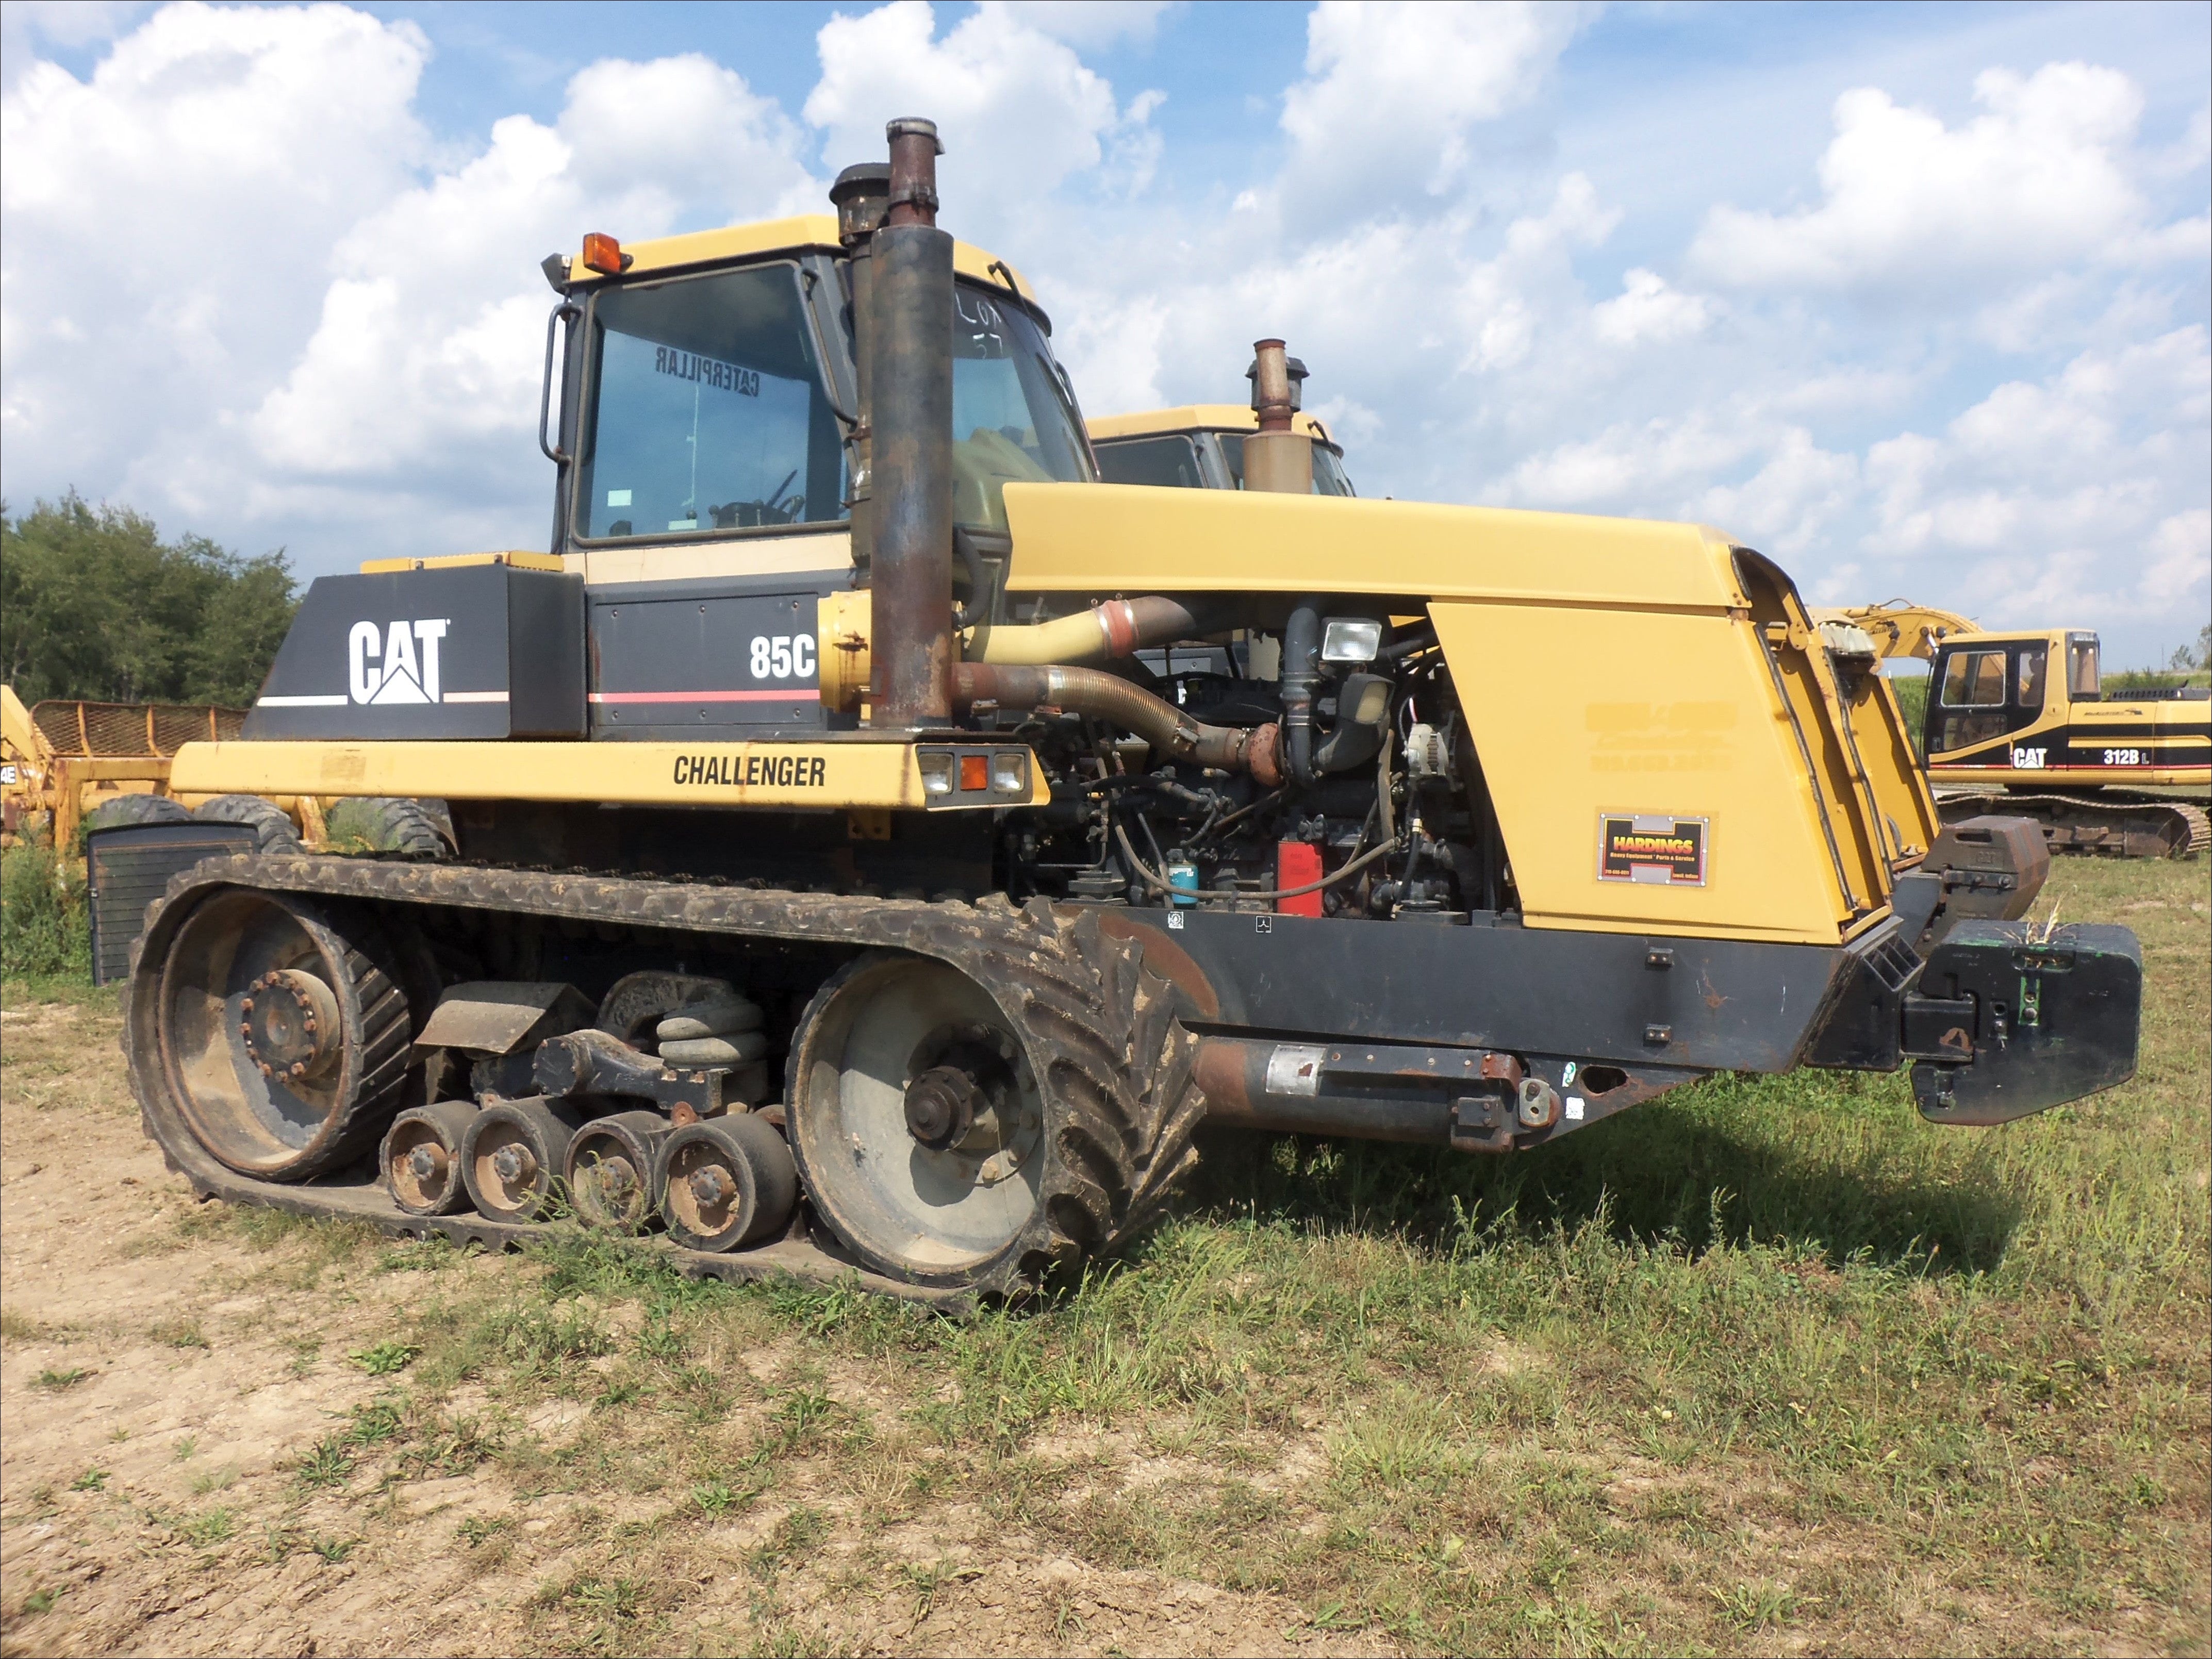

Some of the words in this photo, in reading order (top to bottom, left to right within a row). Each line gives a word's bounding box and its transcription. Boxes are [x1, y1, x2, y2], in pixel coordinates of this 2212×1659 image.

[349, 619, 447, 704] CAT
[750, 634, 815, 678] 85C
[2013, 748, 2046, 768] CAT
[2104, 749, 2139, 765] 312B
[2141, 753, 2150, 765] L
[673, 755, 826, 786] CHALLENGER
[1613, 836, 1693, 854] HARDINGS
